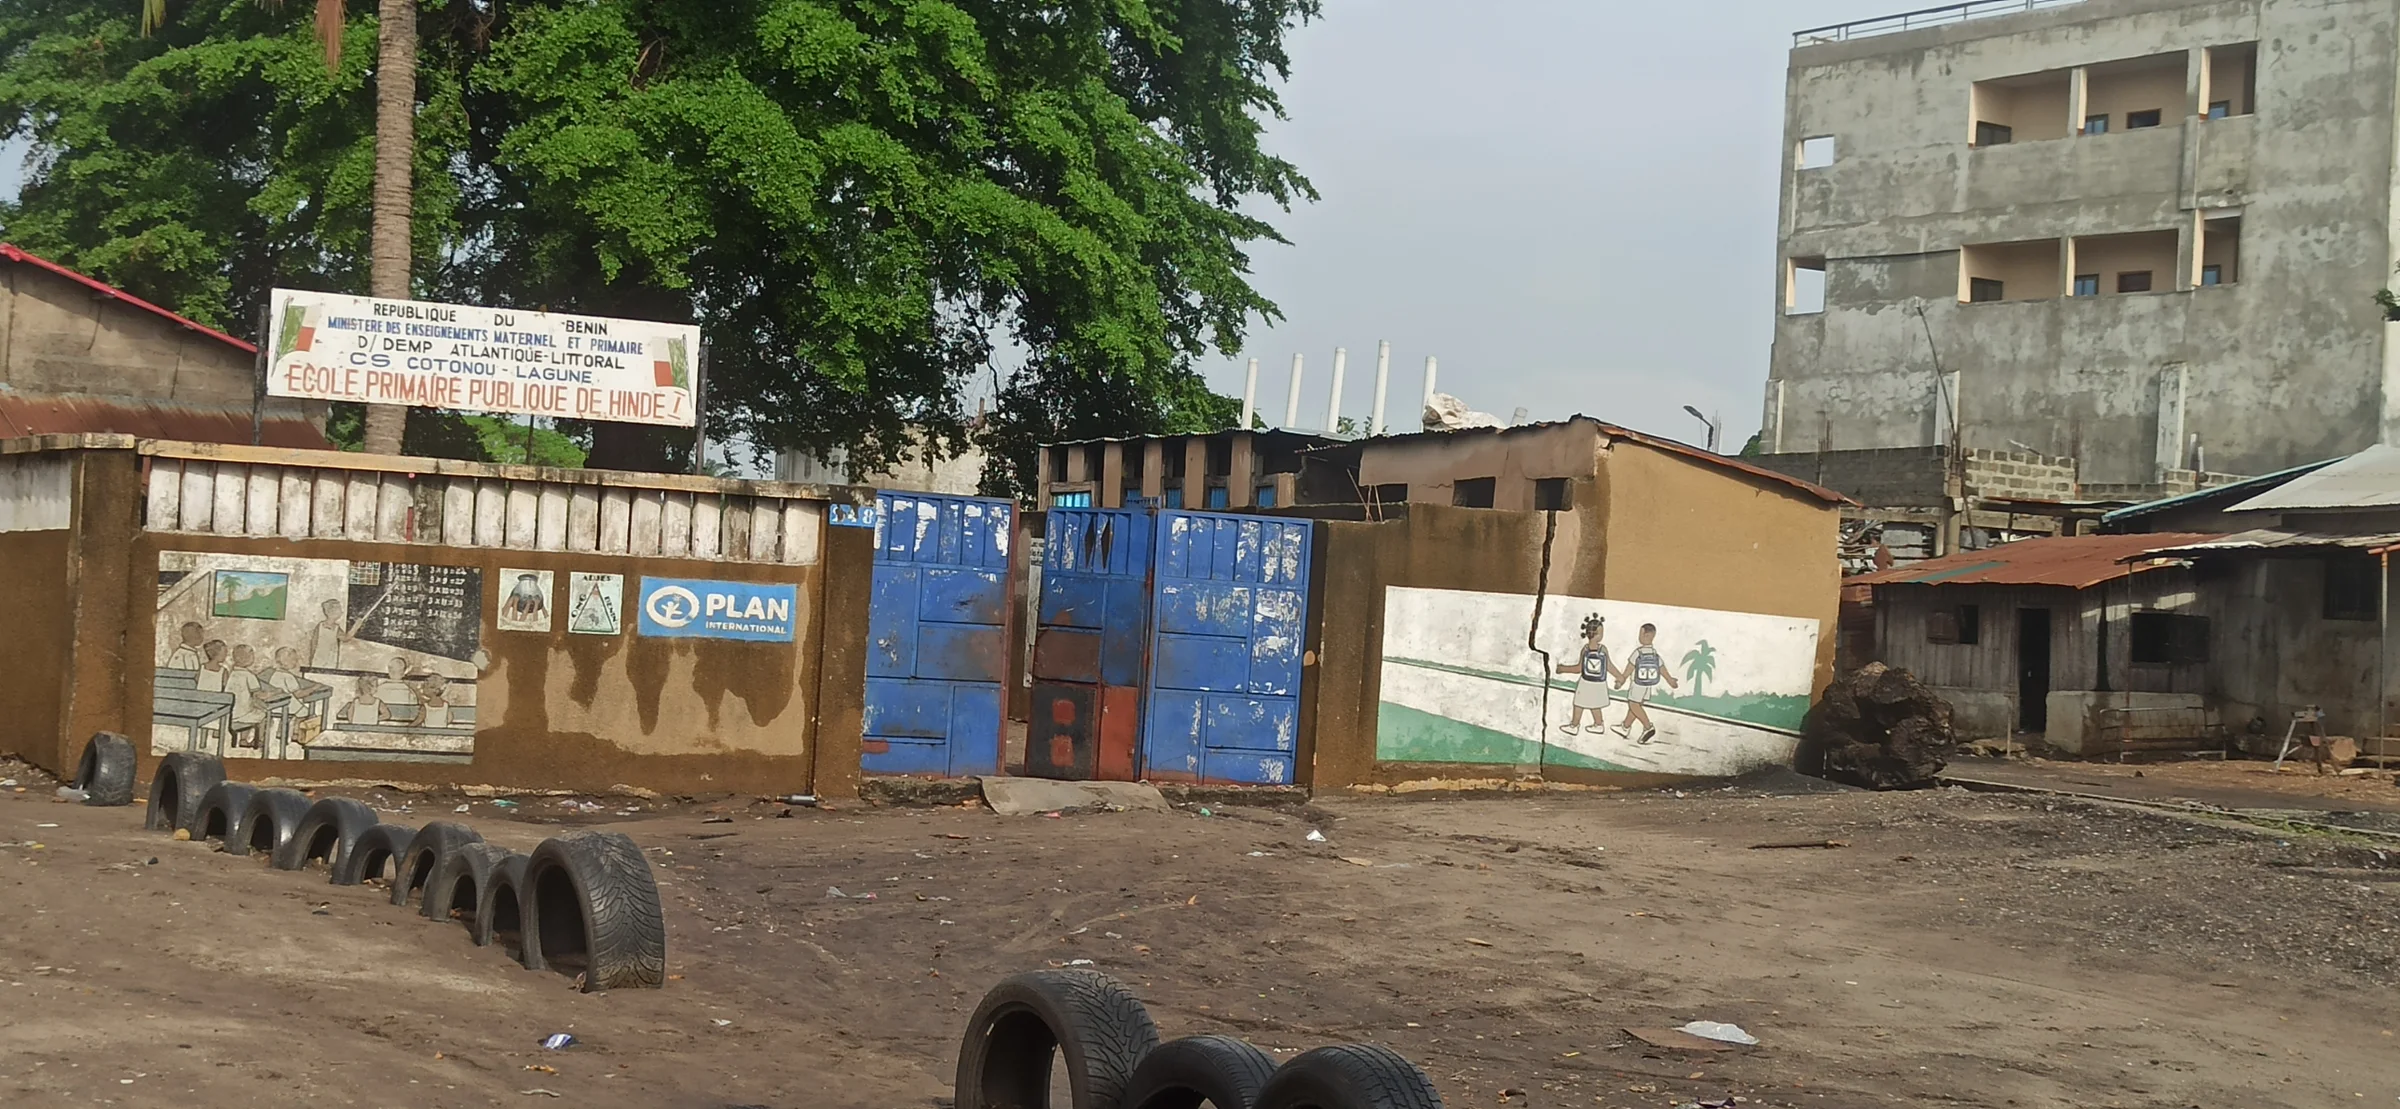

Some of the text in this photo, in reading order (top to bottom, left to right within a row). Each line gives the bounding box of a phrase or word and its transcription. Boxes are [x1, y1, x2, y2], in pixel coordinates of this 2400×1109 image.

[374, 303, 608, 335] REPUBLIQUE DU BENIN
[328, 316, 643, 355] MINISTERE DES ENSEIGNEMENTS MATERNEL ET PRIMAIRE
[350, 352, 391, 368] CS
[407, 356, 495, 376] COTONOU
[516, 365, 593, 384] LAGUNE
[286, 363, 360, 396] ECOLE
[366, 369, 462, 405] PRIMAIRE
[469, 379, 568, 411] PUBLIQUE
[575, 387, 601, 415] DE
[609, 389, 665, 419] HINDE
[706, 593, 789, 622] PLAN
[705, 621, 787, 635] INTERNATIONAL
